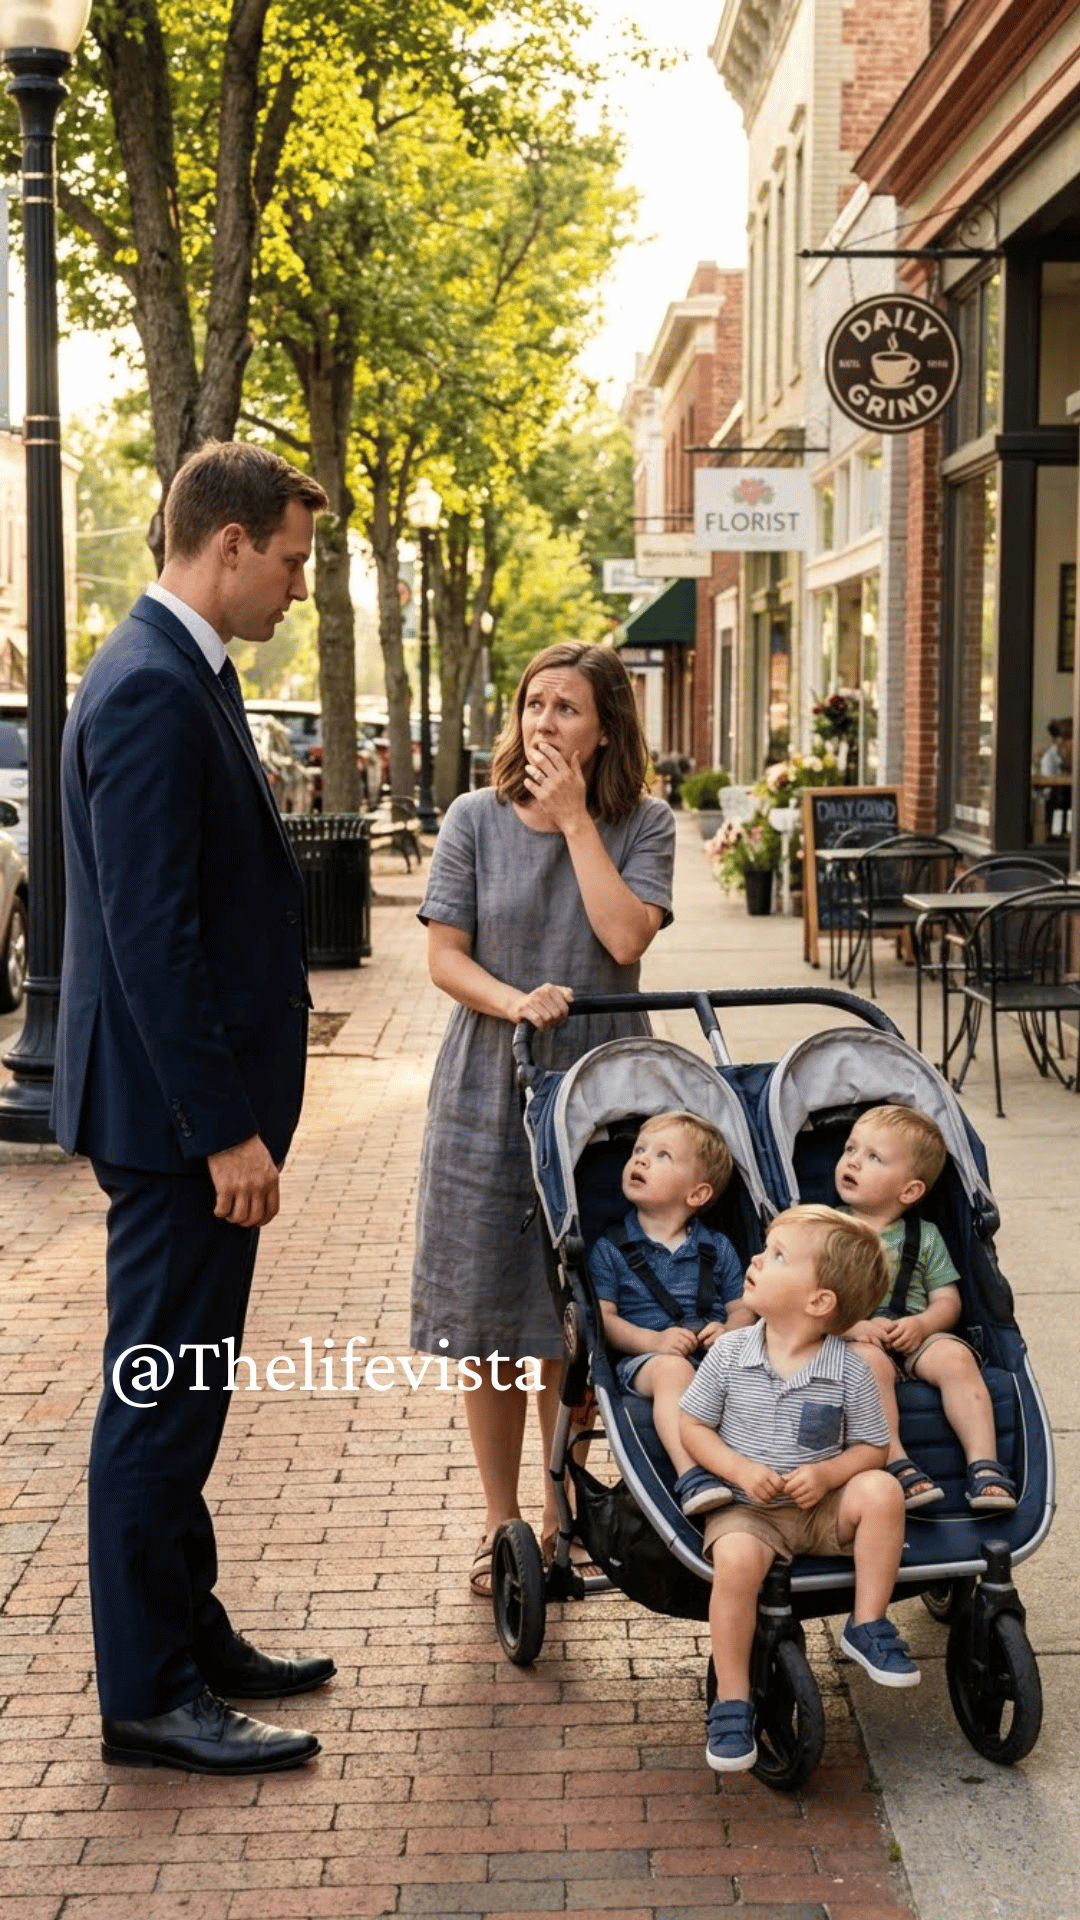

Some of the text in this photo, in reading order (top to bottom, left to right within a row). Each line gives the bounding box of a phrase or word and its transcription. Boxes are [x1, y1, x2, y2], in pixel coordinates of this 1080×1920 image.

[849, 308, 939, 343] DAILY
[848, 384, 937, 420] GRIND
[705, 512, 799, 532] FLORIST
